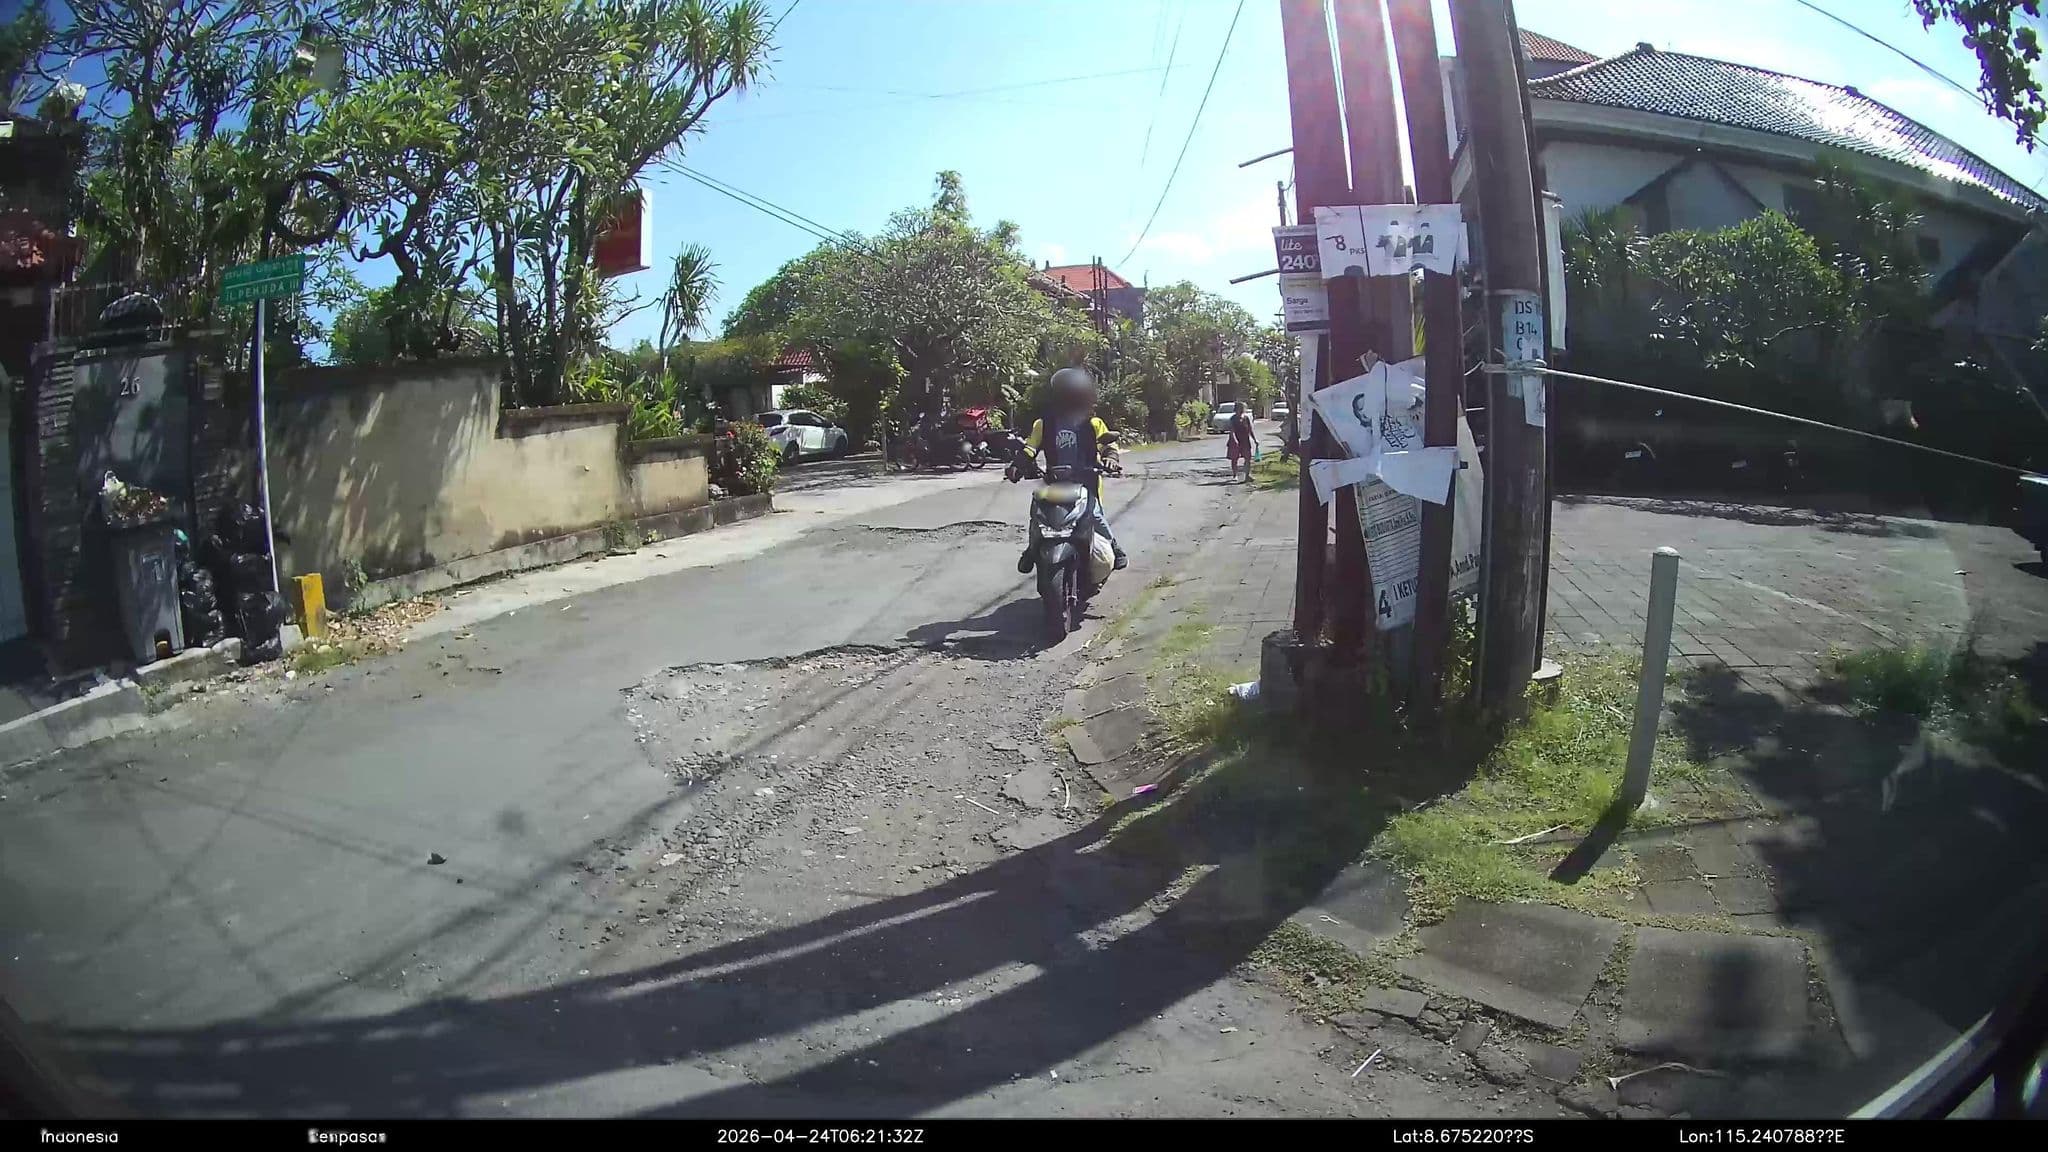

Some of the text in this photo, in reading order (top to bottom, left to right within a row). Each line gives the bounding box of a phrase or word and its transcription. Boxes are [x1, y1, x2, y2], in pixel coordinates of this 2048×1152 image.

[1281, 239, 1303, 251] lite
[121, 376, 141, 396] 26
[1379, 589, 1392, 618] 4
